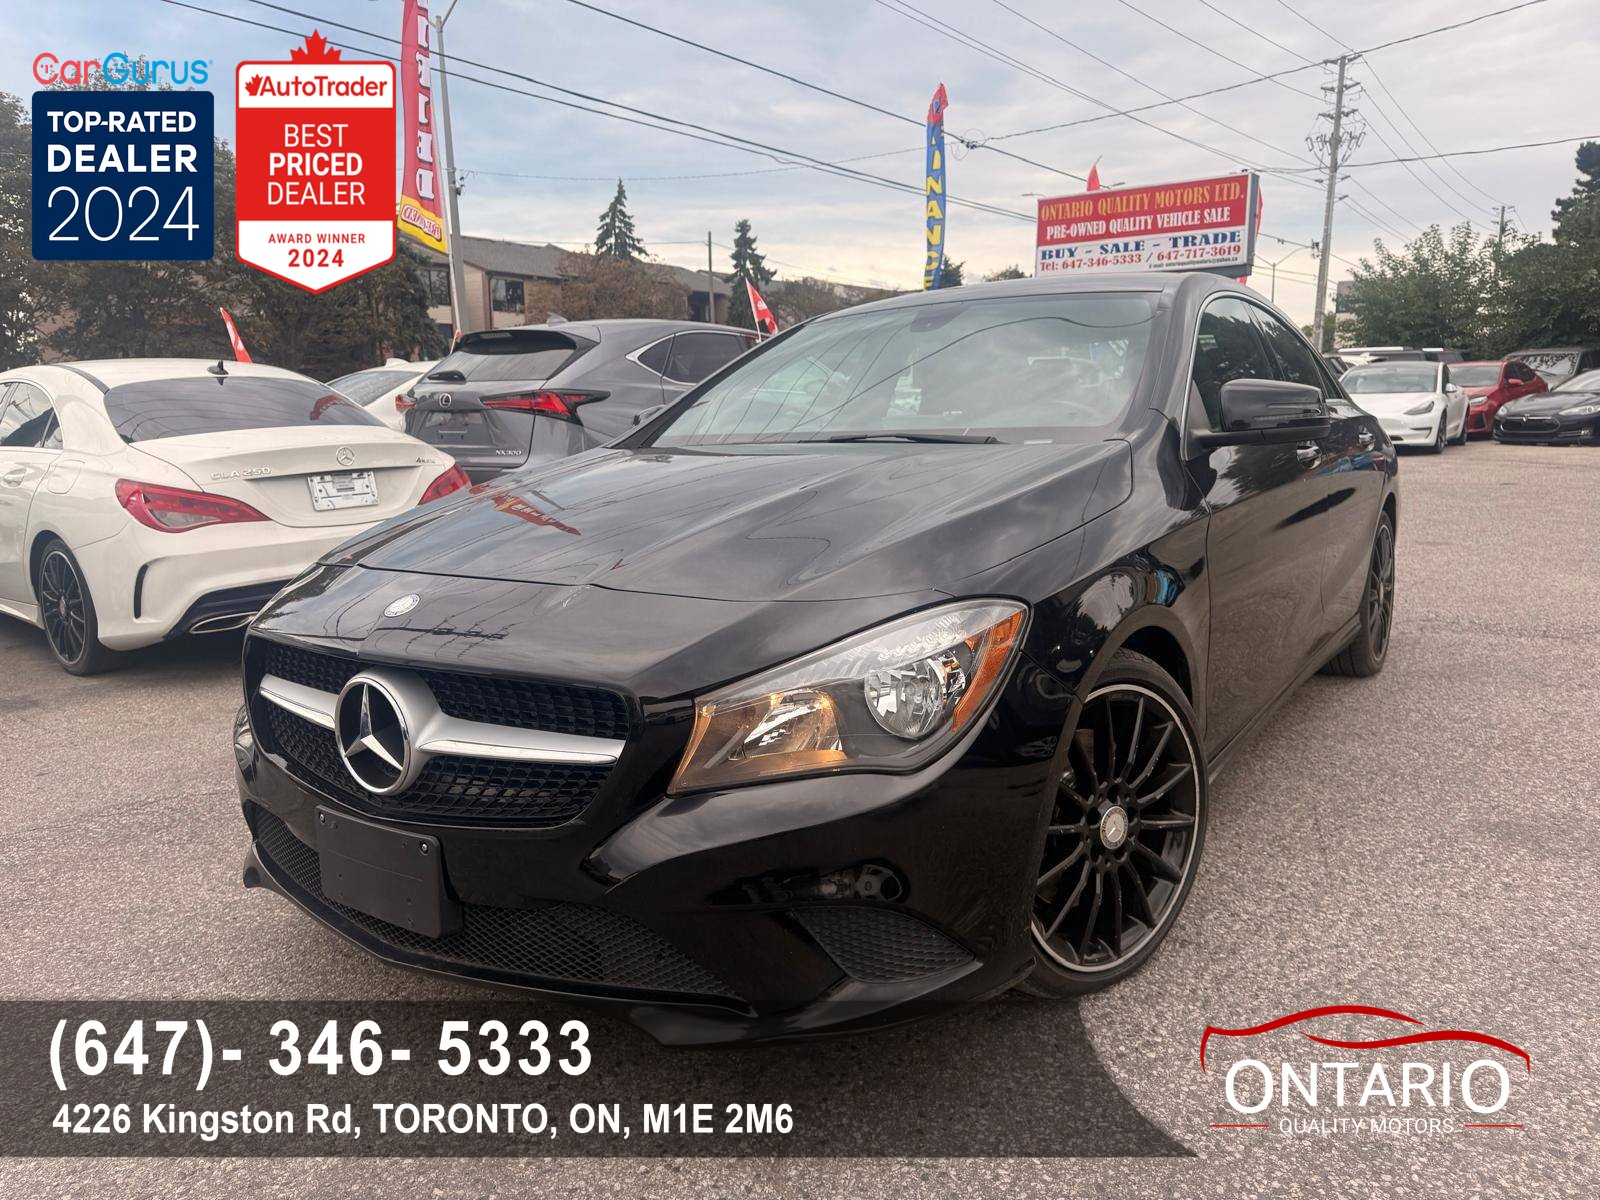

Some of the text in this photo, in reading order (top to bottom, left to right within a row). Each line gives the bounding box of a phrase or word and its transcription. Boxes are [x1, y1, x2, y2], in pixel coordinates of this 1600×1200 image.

[1041, 182, 1245, 221] ONTARIO QUALITY MOTORS LTD.
[1046, 207, 1231, 240] PRE-OWNED QUALITY VEHICLE SALE
[1040, 261, 1058, 272] Tel:
[1062, 253, 1142, 270] 647-346-5333
[1157, 245, 1241, 262] 647-717-3619
[1041, 247, 1078, 260] BUY
[1100, 240, 1145, 255] SALE
[1169, 231, 1241, 249] TRADE
[210, 466, 272, 481] CLA 250
